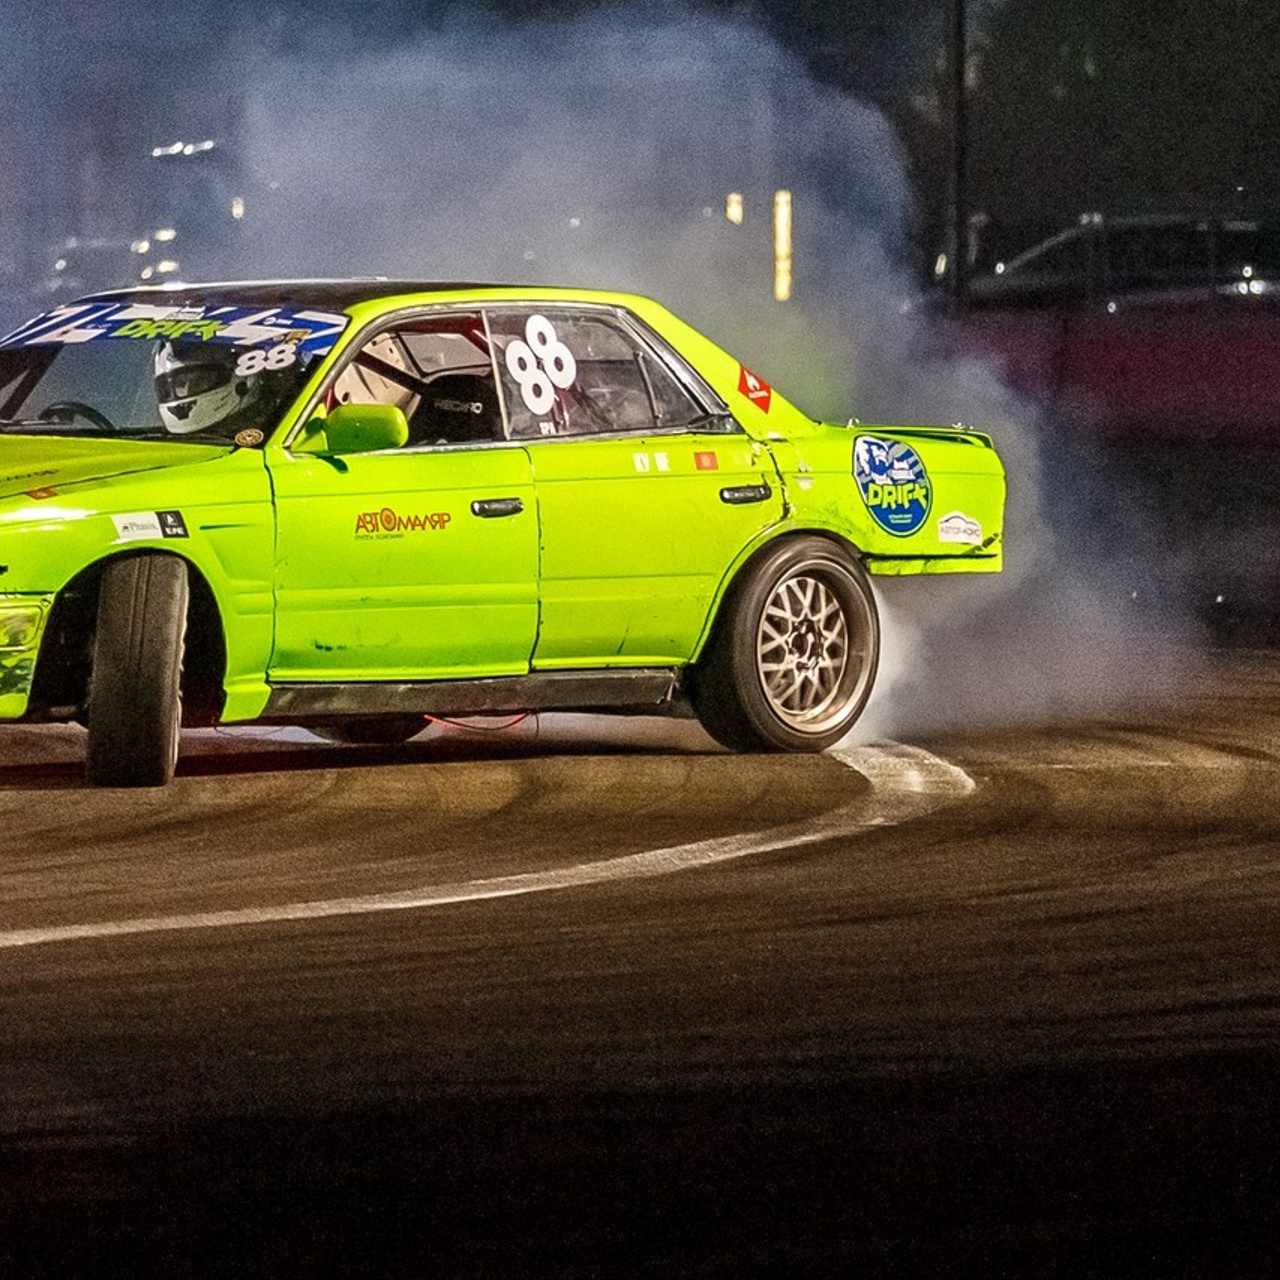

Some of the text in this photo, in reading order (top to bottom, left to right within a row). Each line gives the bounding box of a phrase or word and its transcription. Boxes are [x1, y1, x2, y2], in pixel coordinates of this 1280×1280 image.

[109, 319, 228, 341] DRIFT
[235, 343, 297, 377] 88
[505, 314, 577, 416] 88
[867, 482, 927, 511] DRIFT
